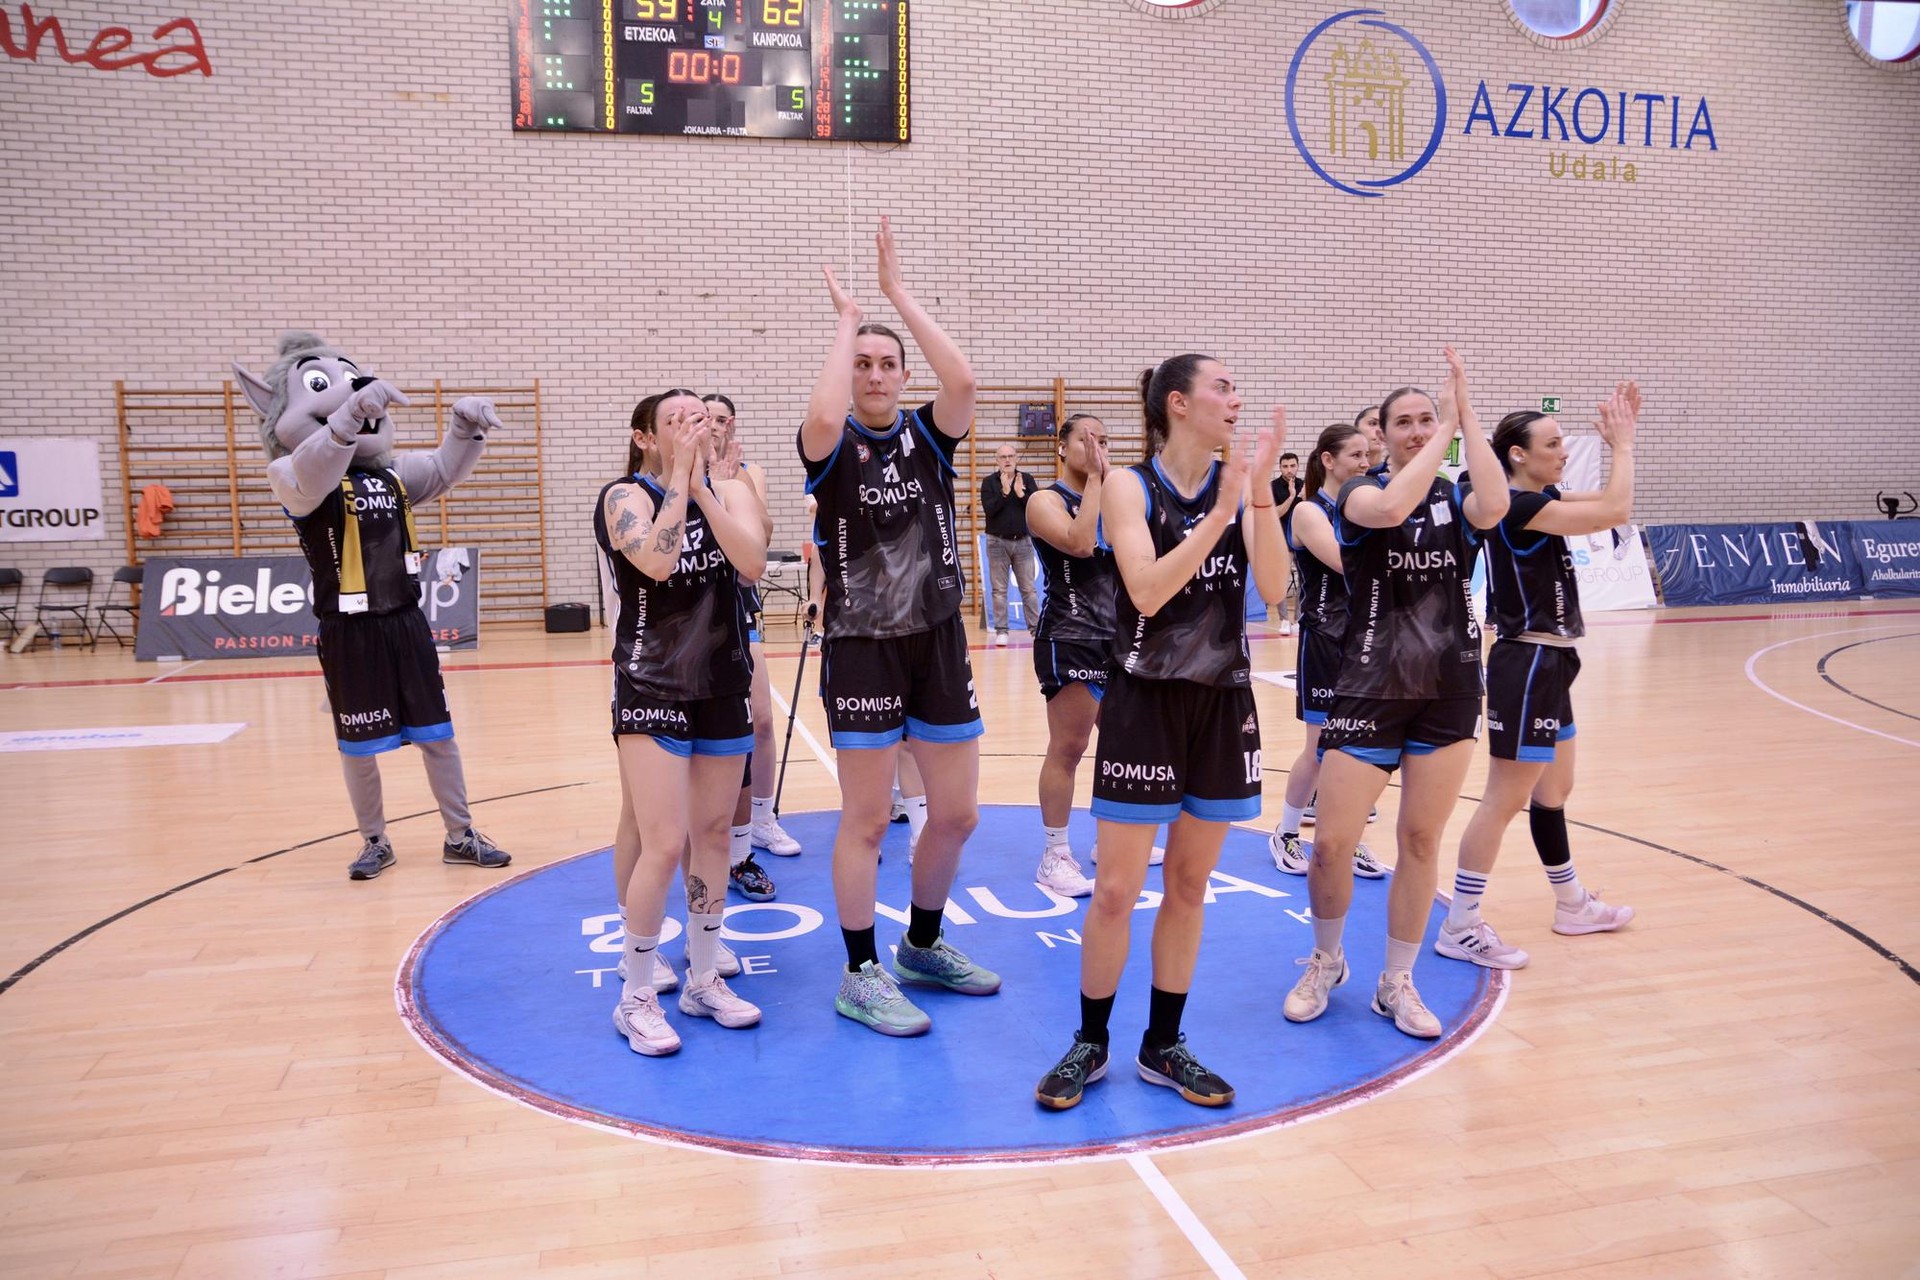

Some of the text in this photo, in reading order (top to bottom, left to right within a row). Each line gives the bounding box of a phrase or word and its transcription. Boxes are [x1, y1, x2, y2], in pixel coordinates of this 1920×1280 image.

[708, 11, 722, 29] 4
[763, 0, 802, 26] 62
[624, 26, 676, 43] ETXEKOA
[753, 32, 802, 48] KANPOKOA
[641, 83, 654, 104] 5
[791, 89, 804, 109] 5
[626, 106, 653, 115] FALTAK
[778, 111, 804, 121] FALTAK
[1463, 79, 1718, 151] AZKOITIA
[683, 126, 721, 135] JOKALARIA
[726, 128, 747, 136] FALTA
[817, 125, 831, 136] 93
[1549, 152, 1637, 182] Udala
[362, 478, 387, 493] 12
[354, 496, 398, 512] OMUS
[858, 497, 927, 519] TEKNK
[934, 504, 953, 547] CORTEBI
[837, 517, 848, 560] ALTUNA
[671, 548, 726, 574] MUSA
[1861, 538, 1920, 564] Egure
[1062, 559, 1071, 584] ALTUN
[1385, 569, 1458, 583] TKNI
[1184, 579, 1241, 595] KNIK
[1770, 576, 1851, 594] Inmobiliaria
[637, 587, 647, 627] ALTUNA
[1369, 578, 1380, 619] ALTUNA
[1554, 580, 1565, 616] ALTUNA
[1134, 613, 1146, 640] UNA
[215, 635, 319, 648] PASSION FO
[630, 637, 643, 661] URIA
[1362, 628, 1376, 653] URIA
[836, 696, 903, 712] DOMUSA
[621, 708, 688, 724] DOMUSA
[622, 722, 689, 732] TEKNIK
[1102, 759, 1176, 782] DOMUSA
[1244, 749, 1263, 784] 18
[1102, 778, 1177, 792] TEKNIK
